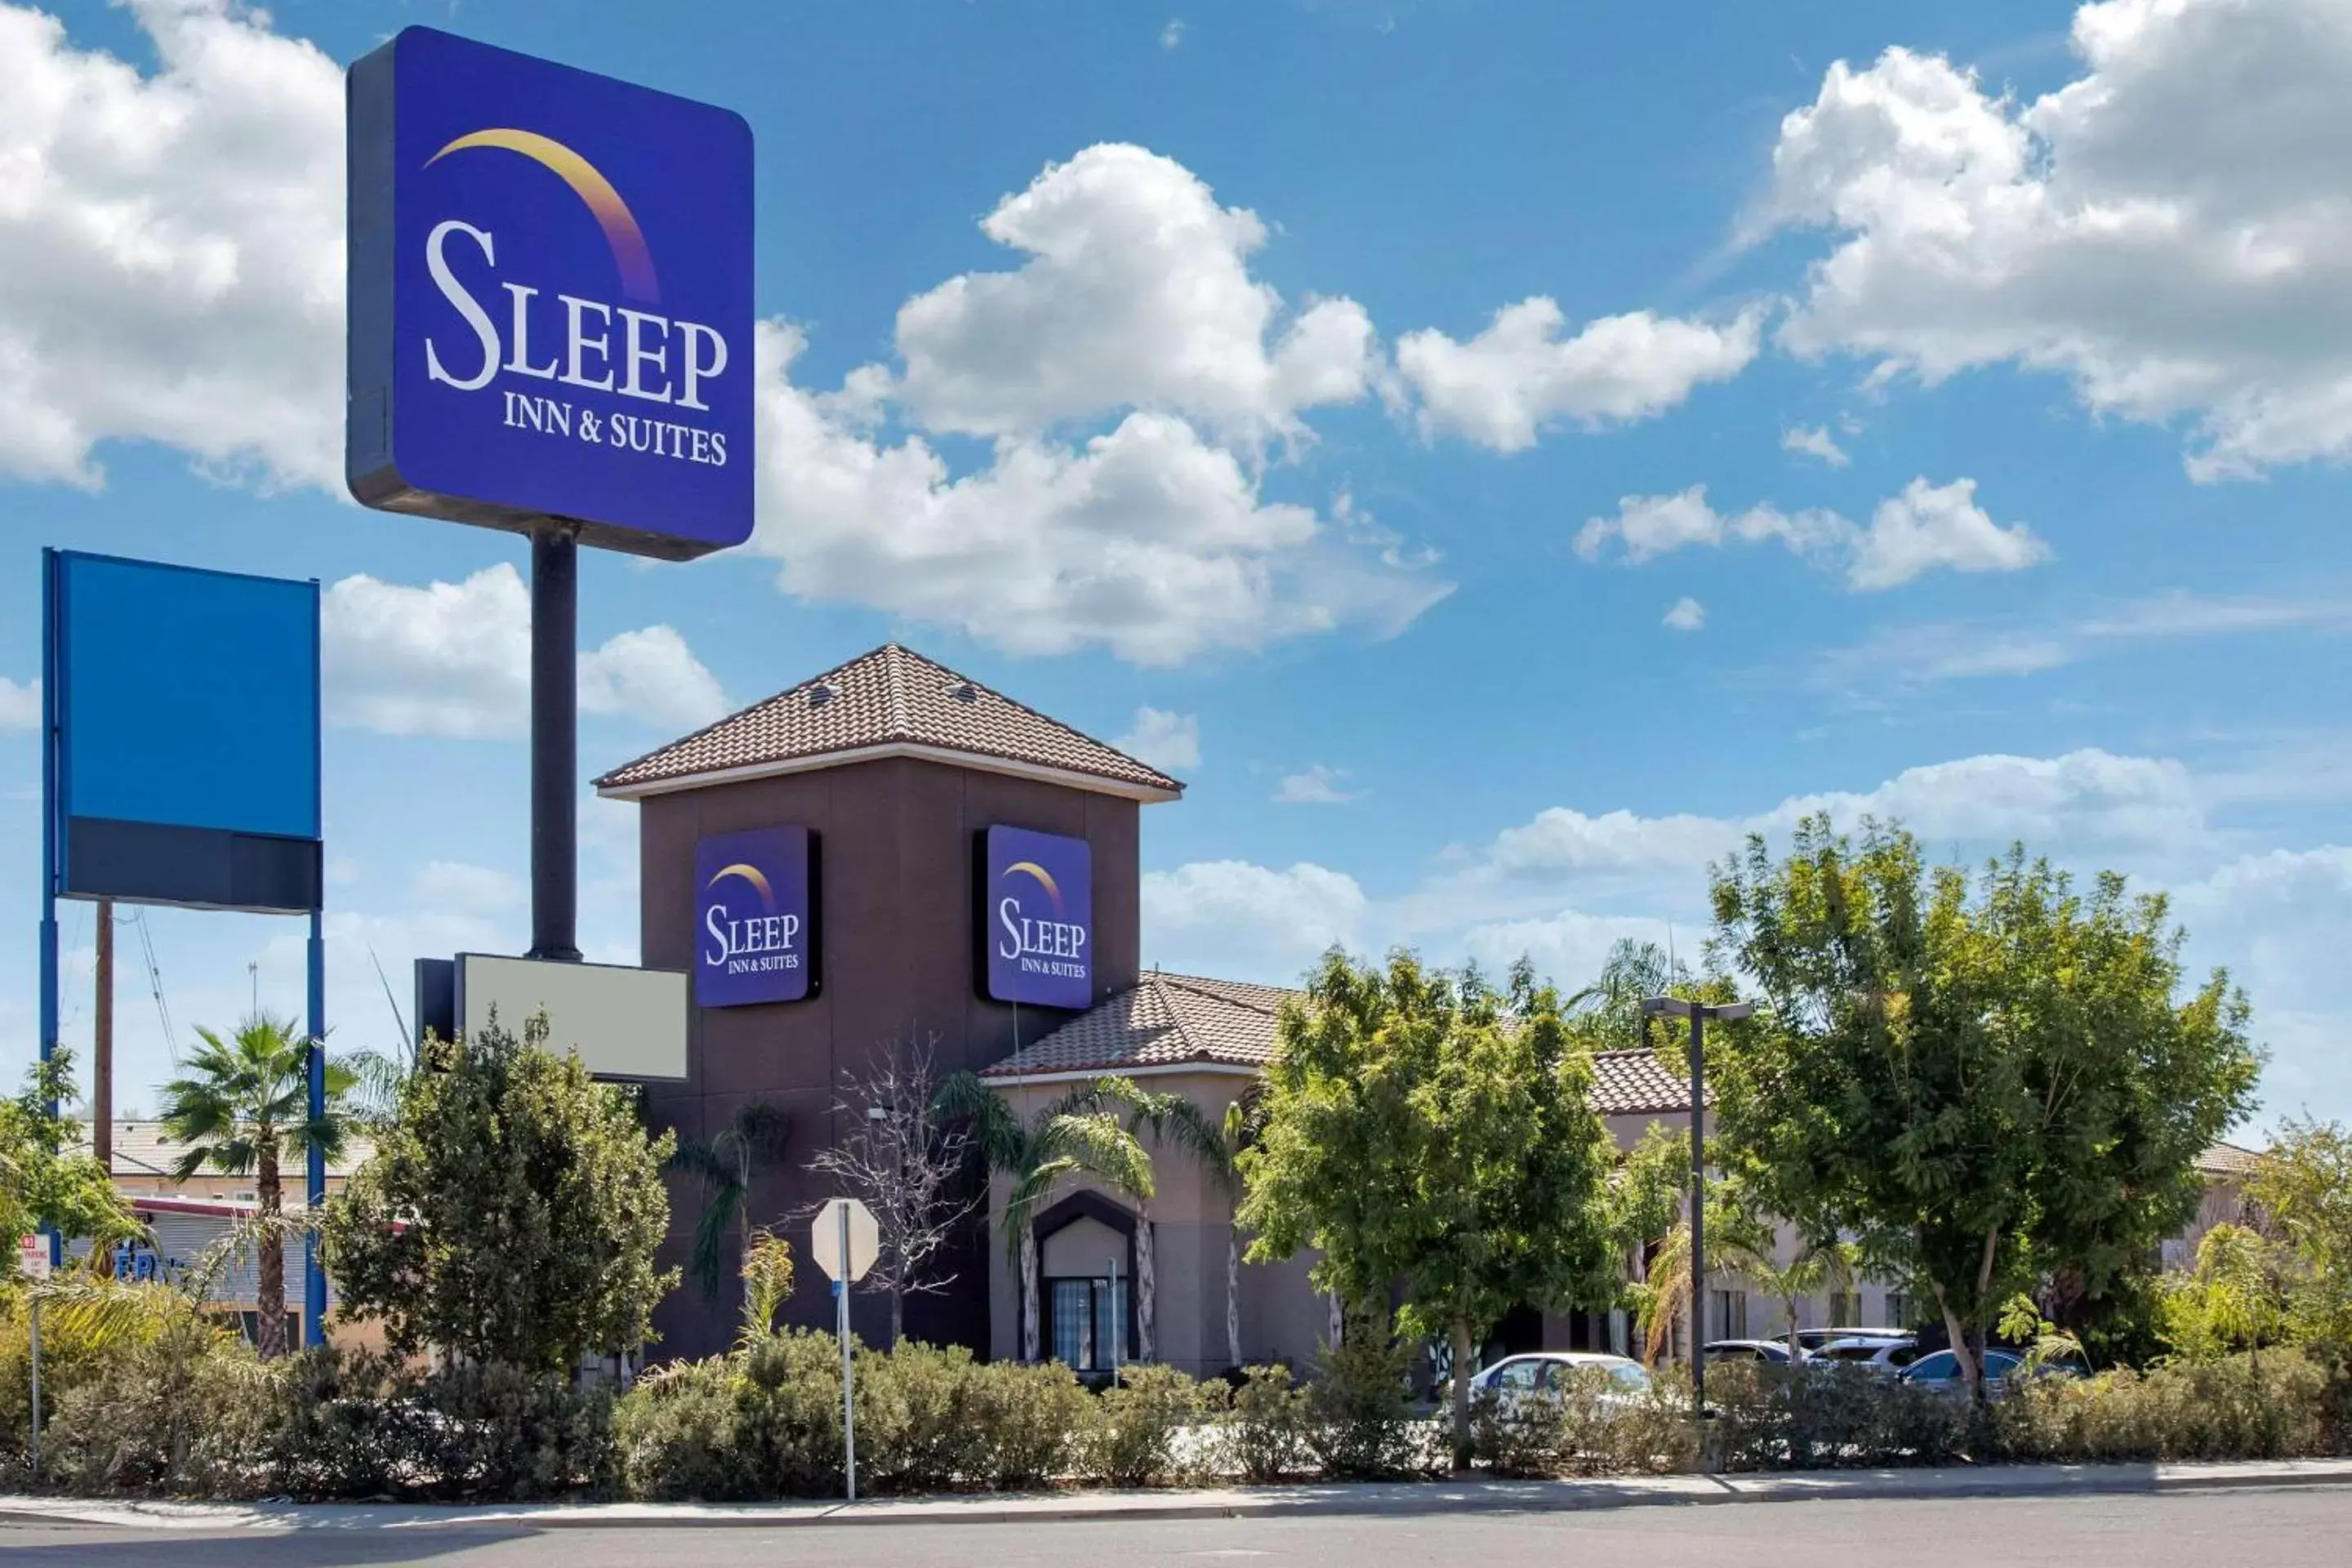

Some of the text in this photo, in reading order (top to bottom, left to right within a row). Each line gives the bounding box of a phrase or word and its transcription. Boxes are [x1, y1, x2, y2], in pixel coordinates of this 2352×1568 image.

[425, 220, 728, 411] SLEEP
[503, 391, 727, 466] INN & SUITES
[706, 904, 799, 966] SLEEP
[1000, 898, 1085, 959] SLEEP
[728, 955, 799, 974] INN & SUITES
[1022, 957, 1085, 978] INN & SUITES
